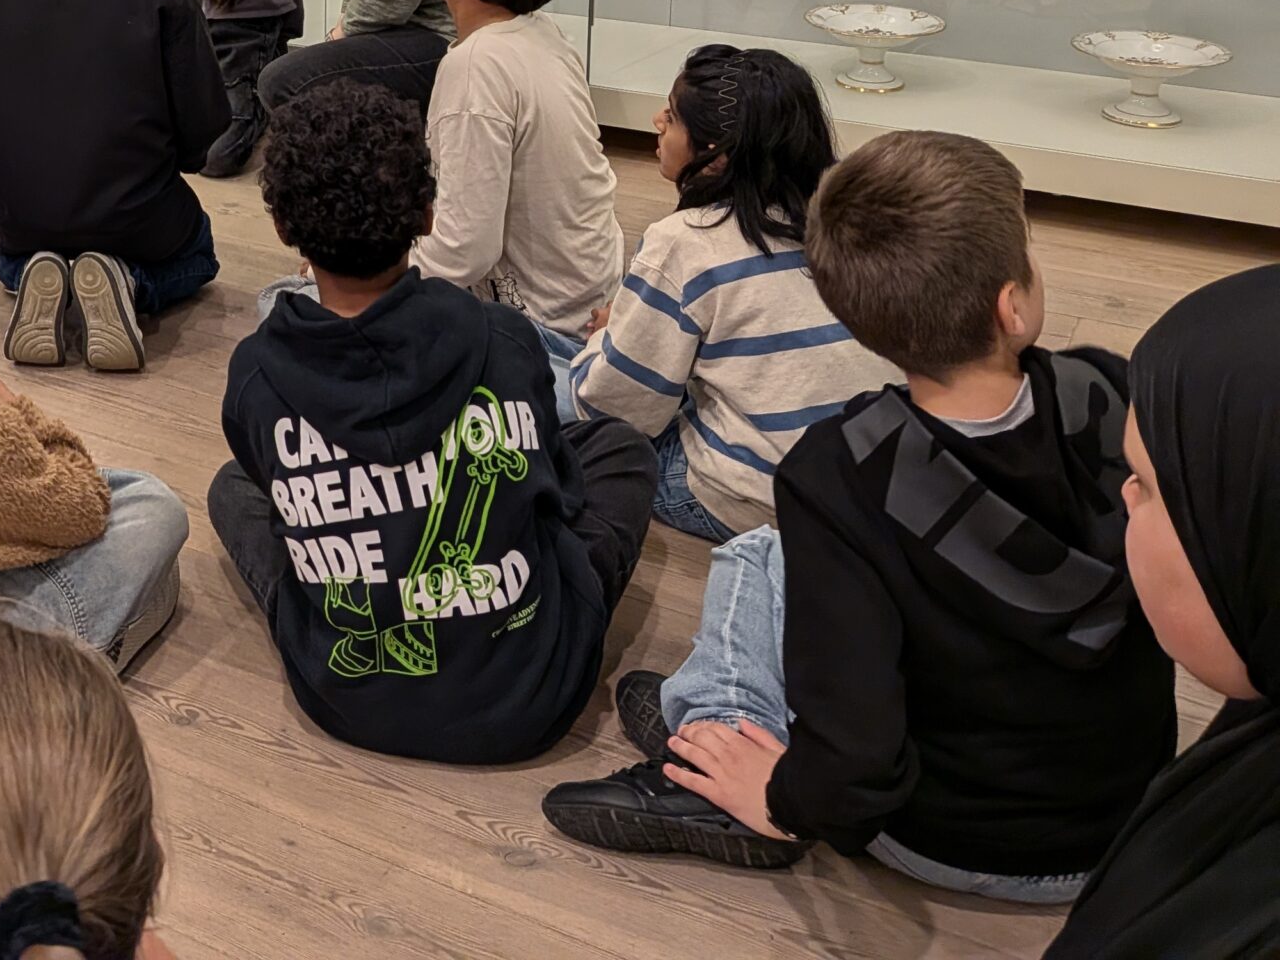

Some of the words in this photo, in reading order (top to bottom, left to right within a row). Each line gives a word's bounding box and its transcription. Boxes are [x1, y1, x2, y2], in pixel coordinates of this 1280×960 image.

[274, 416, 348, 468] CA
[271, 451, 444, 527] BREATH
[284, 530, 388, 584] RIDE
[398, 549, 530, 620] HARD
